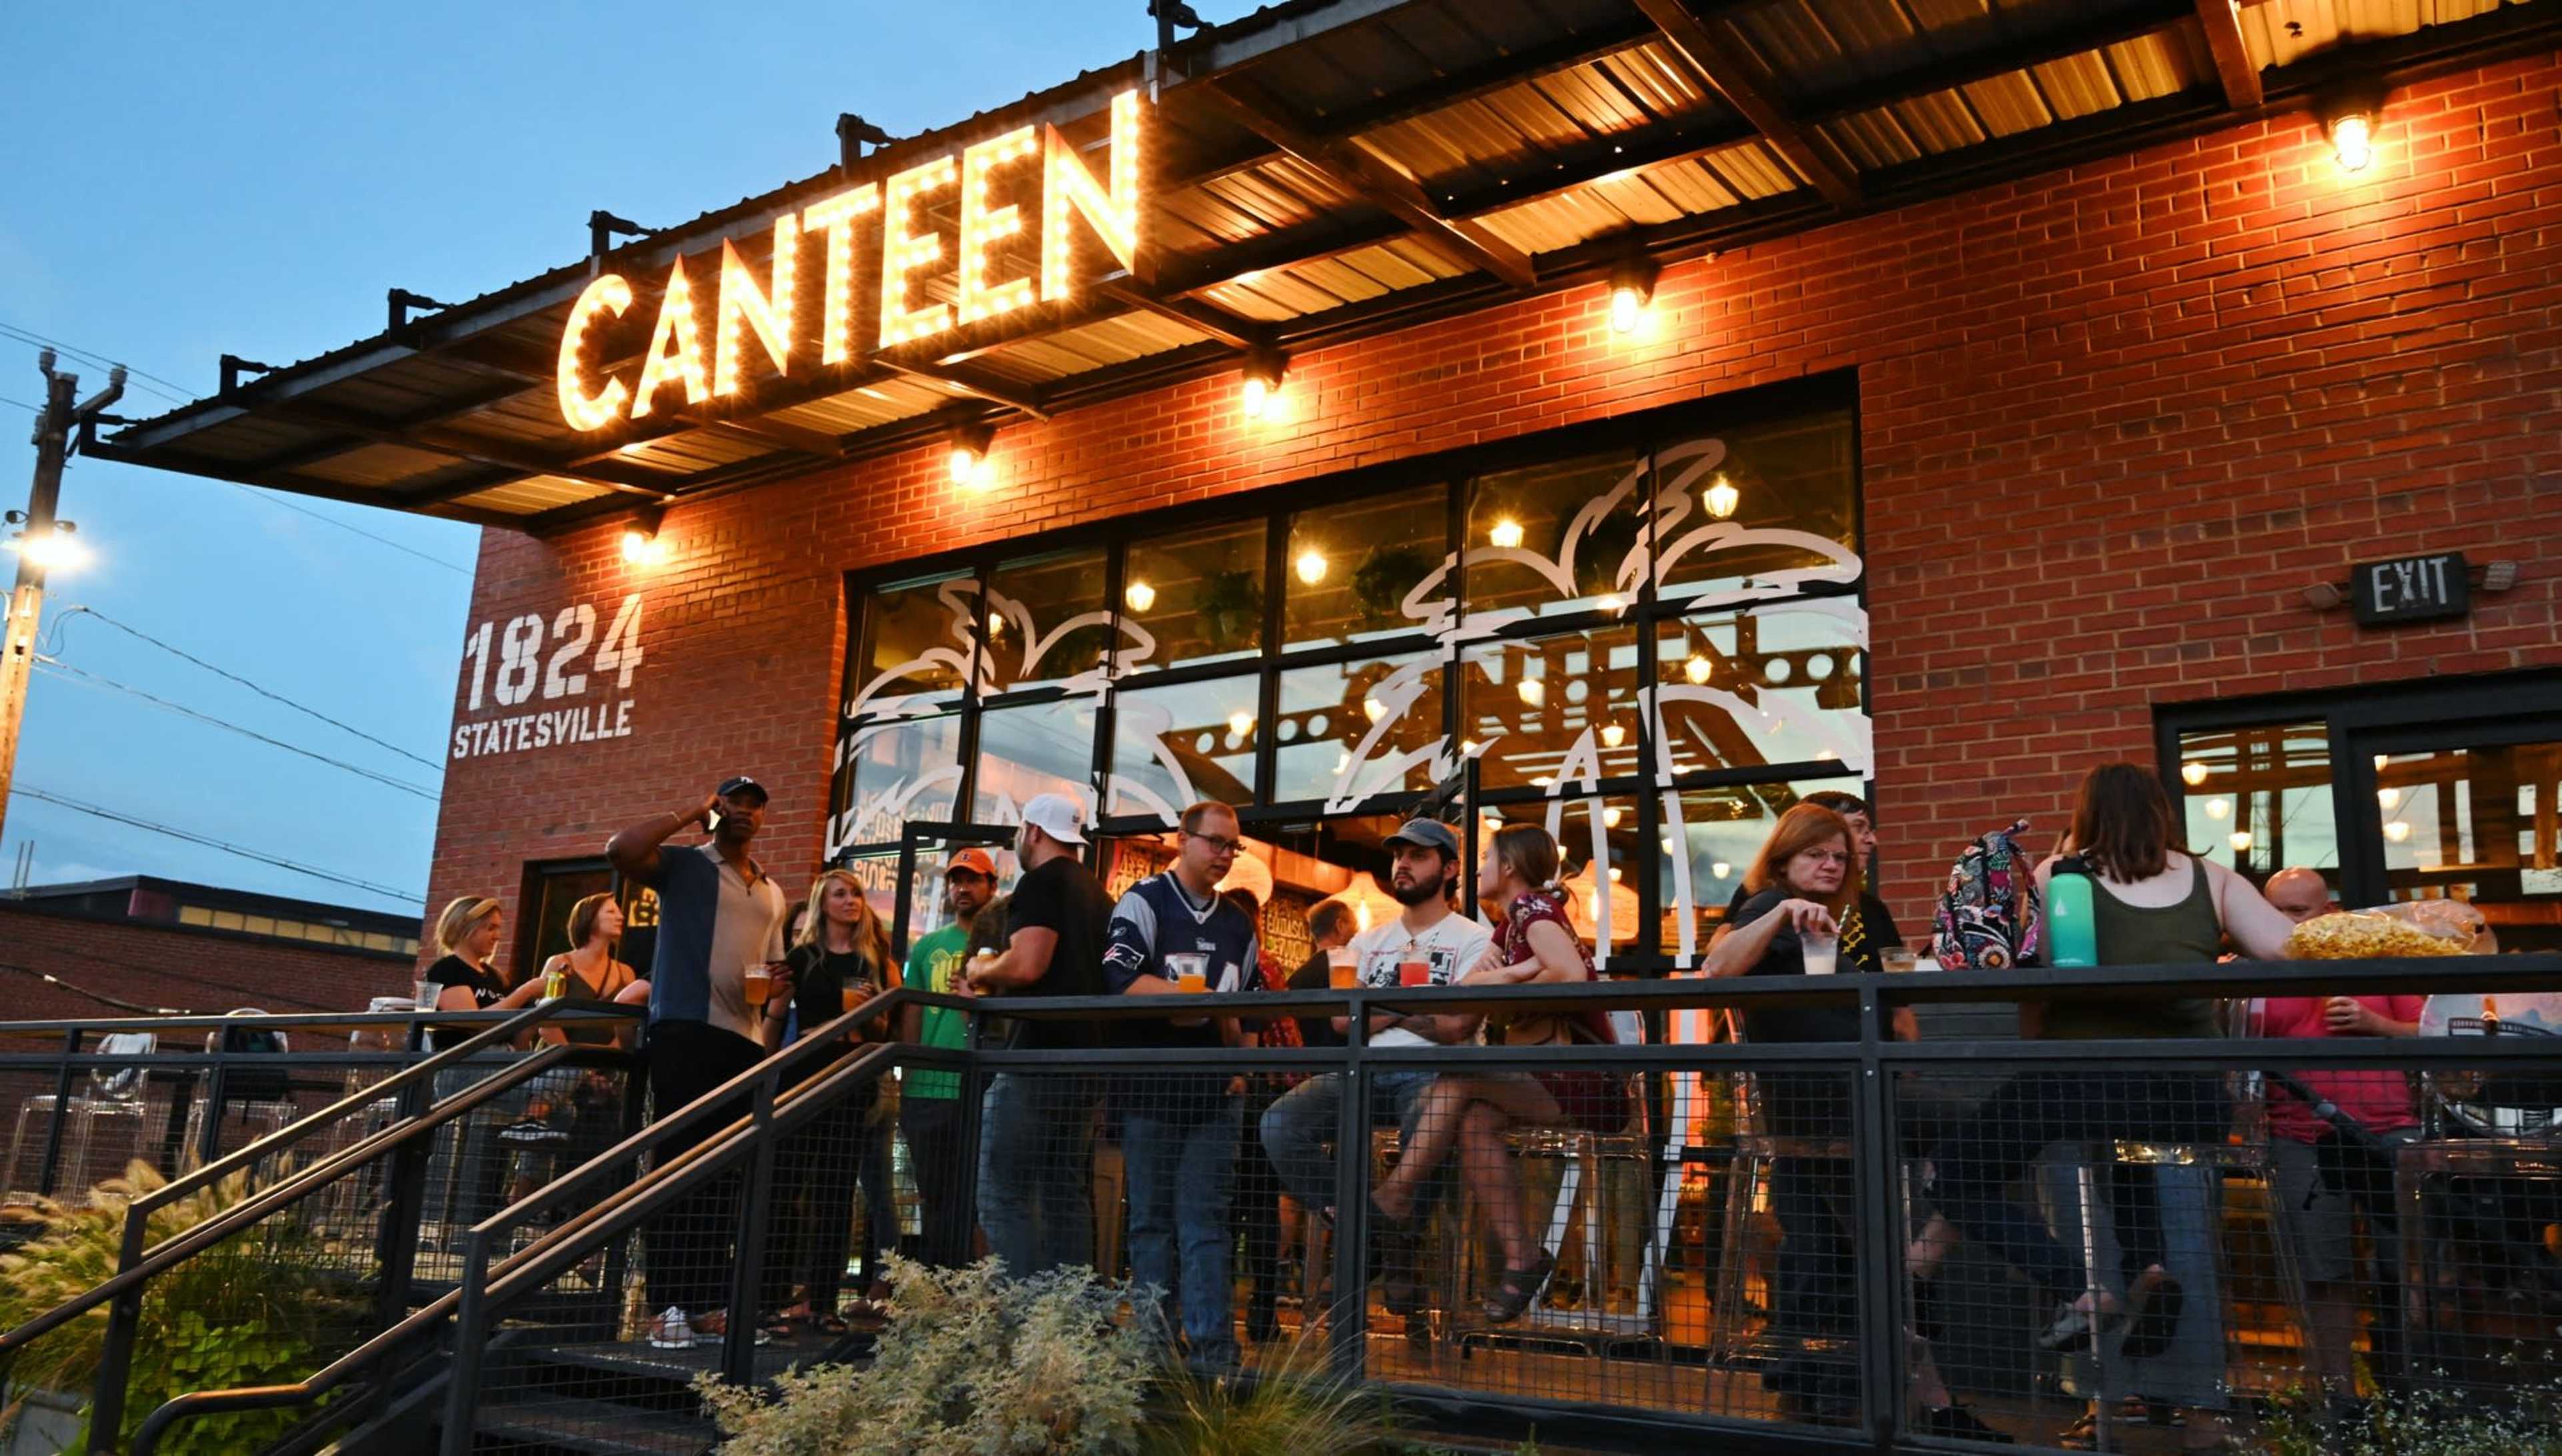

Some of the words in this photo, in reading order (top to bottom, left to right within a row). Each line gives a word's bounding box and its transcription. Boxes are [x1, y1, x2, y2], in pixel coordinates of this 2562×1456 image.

[556, 88, 1140, 432] CANTEEN
[2371, 556, 2449, 613] EXIT
[466, 593, 644, 712] 1824
[452, 699, 635, 760] STATESVILLE
